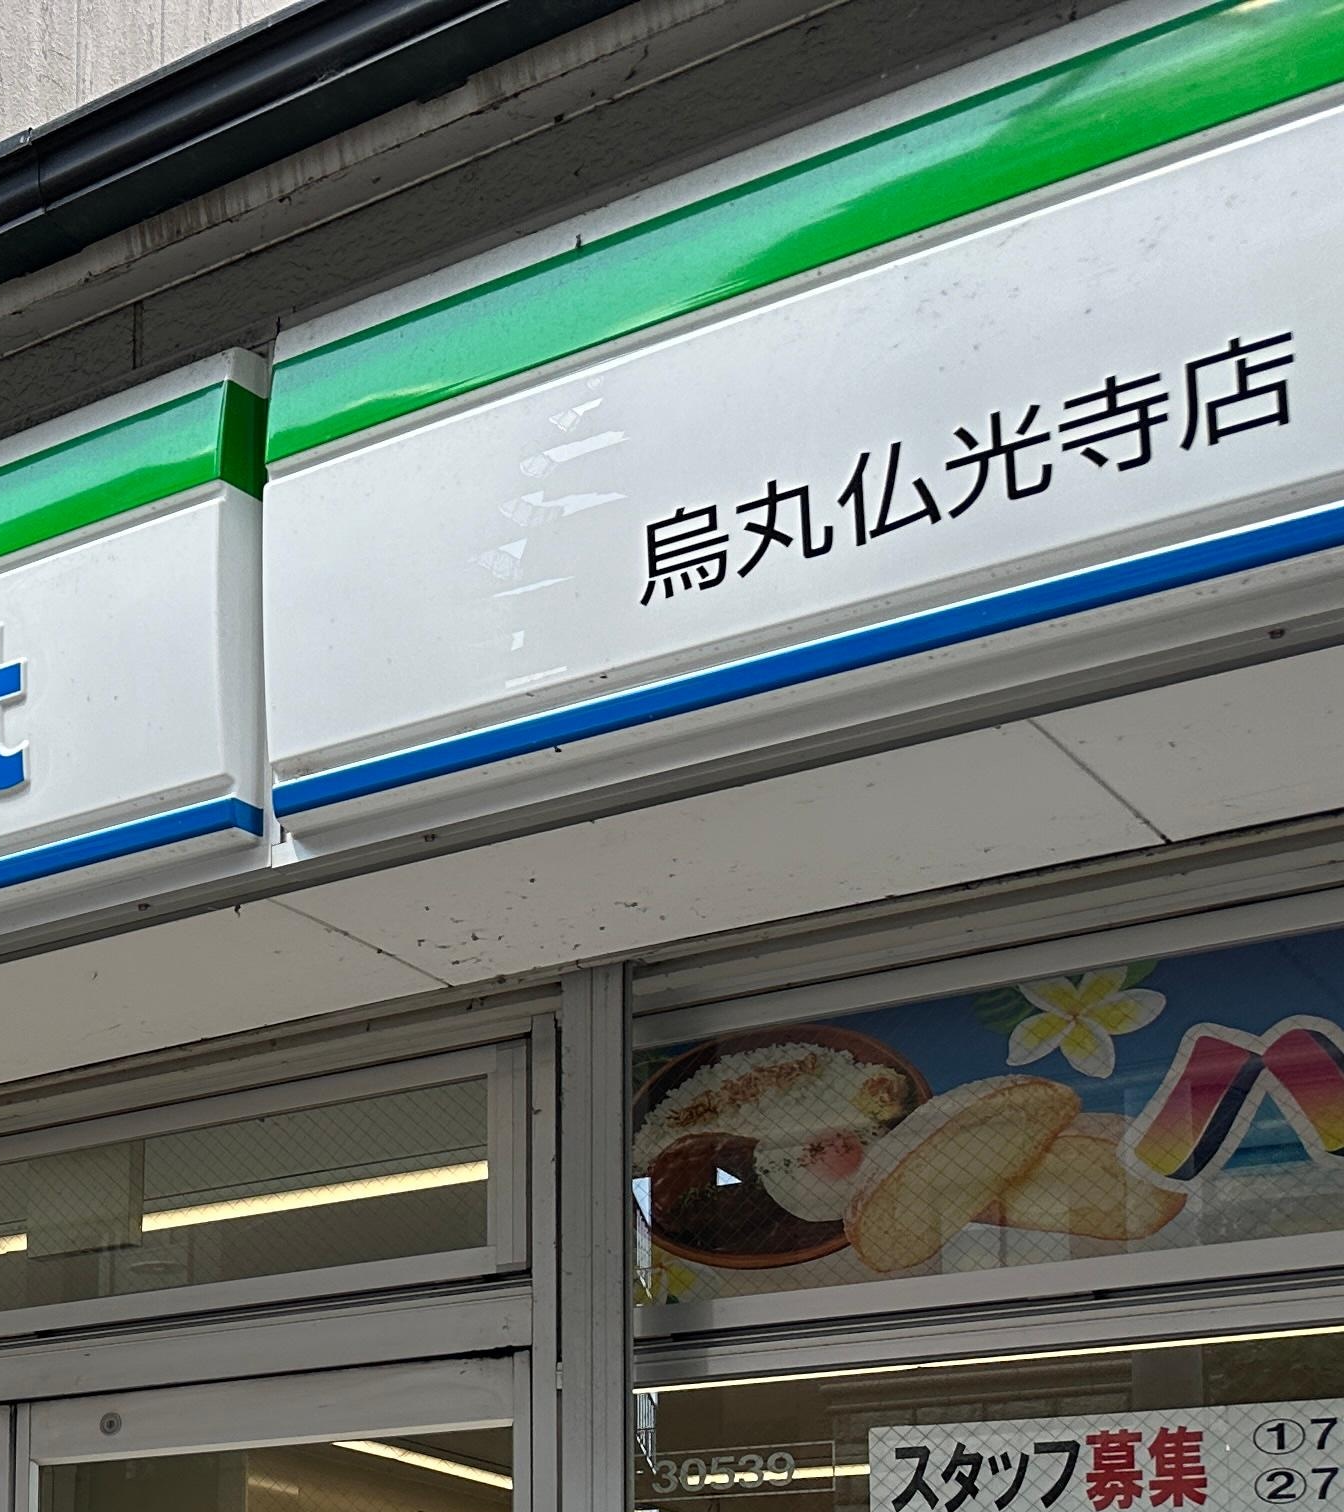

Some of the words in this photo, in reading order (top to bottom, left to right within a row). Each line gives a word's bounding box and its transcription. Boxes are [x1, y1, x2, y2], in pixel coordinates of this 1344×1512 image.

[640, 330, 1295, 606] 烏丸仏光寺店
[653, 1451, 796, 1497] 30539
